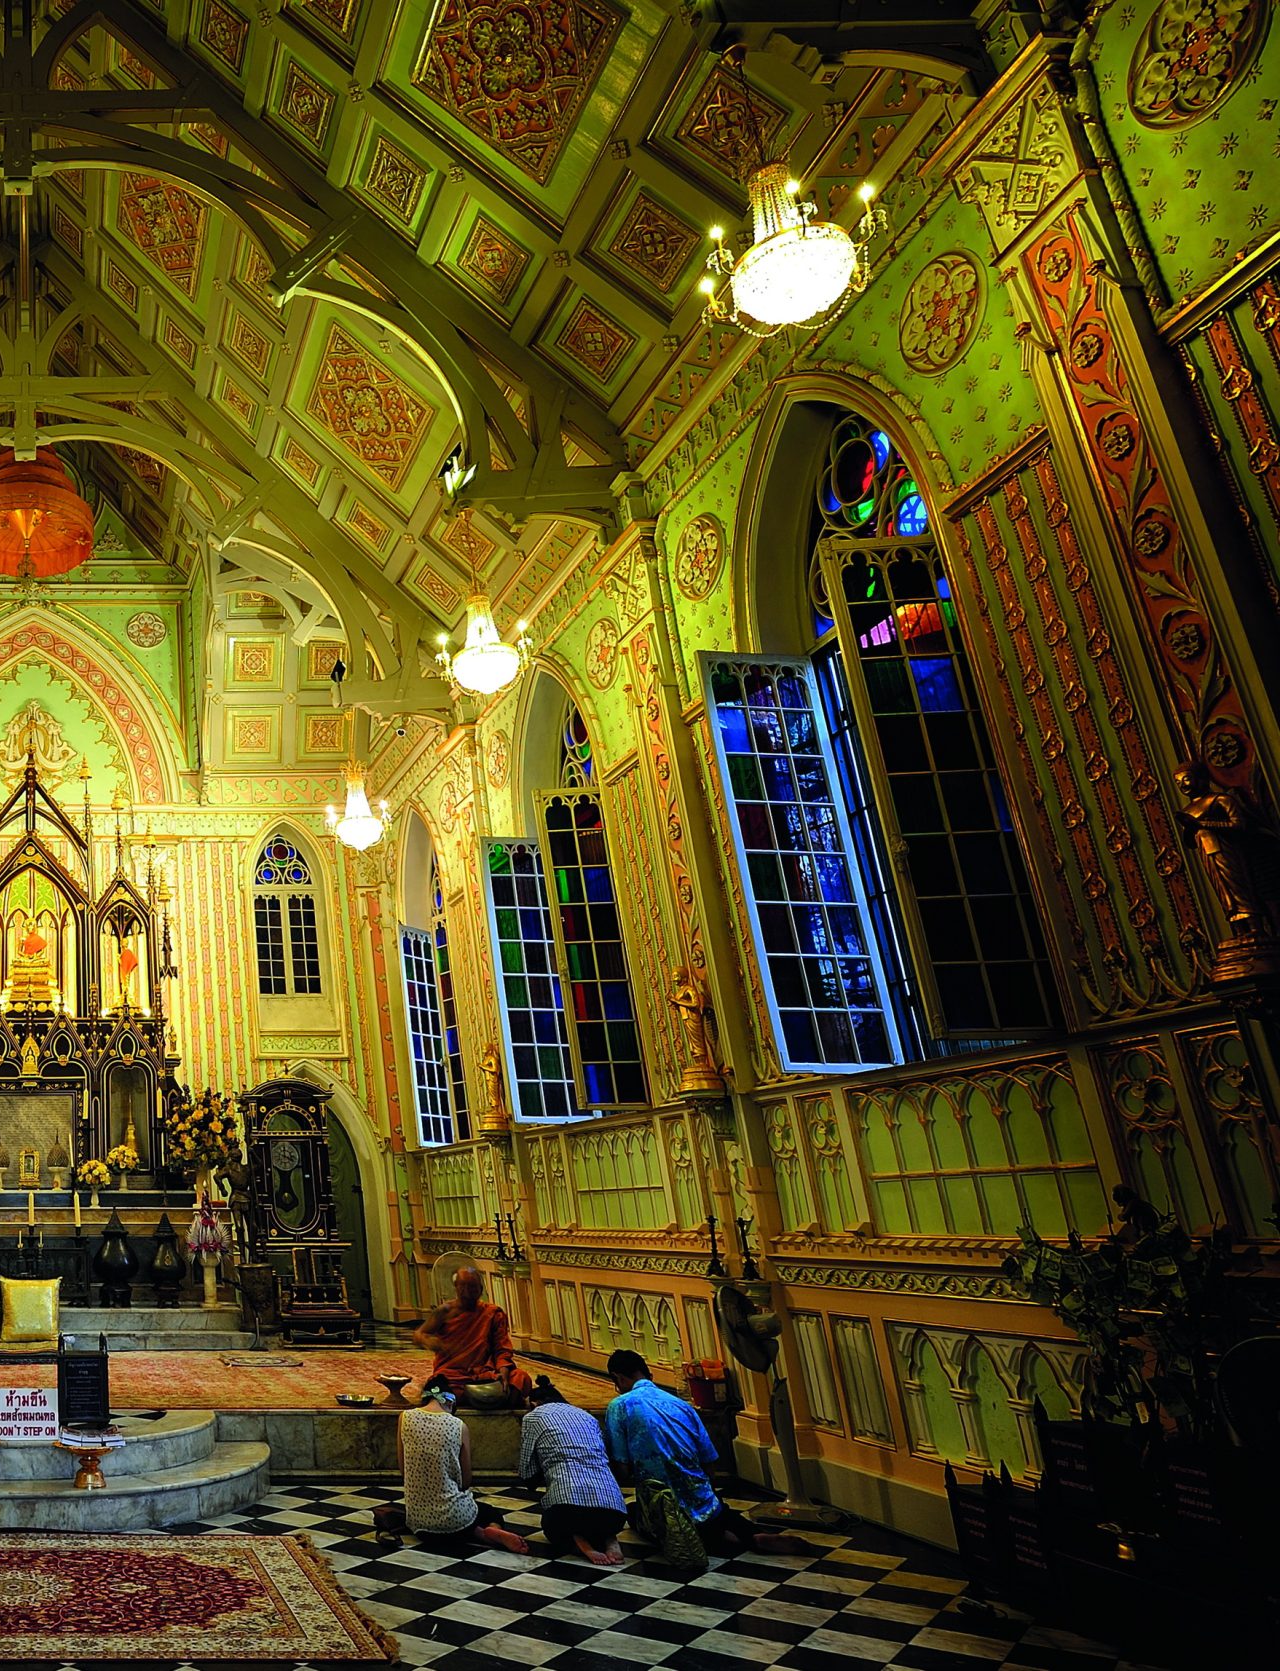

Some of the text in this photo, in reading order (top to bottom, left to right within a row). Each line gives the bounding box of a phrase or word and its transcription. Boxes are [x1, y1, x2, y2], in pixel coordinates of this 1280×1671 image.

[5, 1389, 47, 1407] ห้ามขึ้น
[23, 1426, 43, 1436] STEP
[45, 1426, 56, 1436] ON
